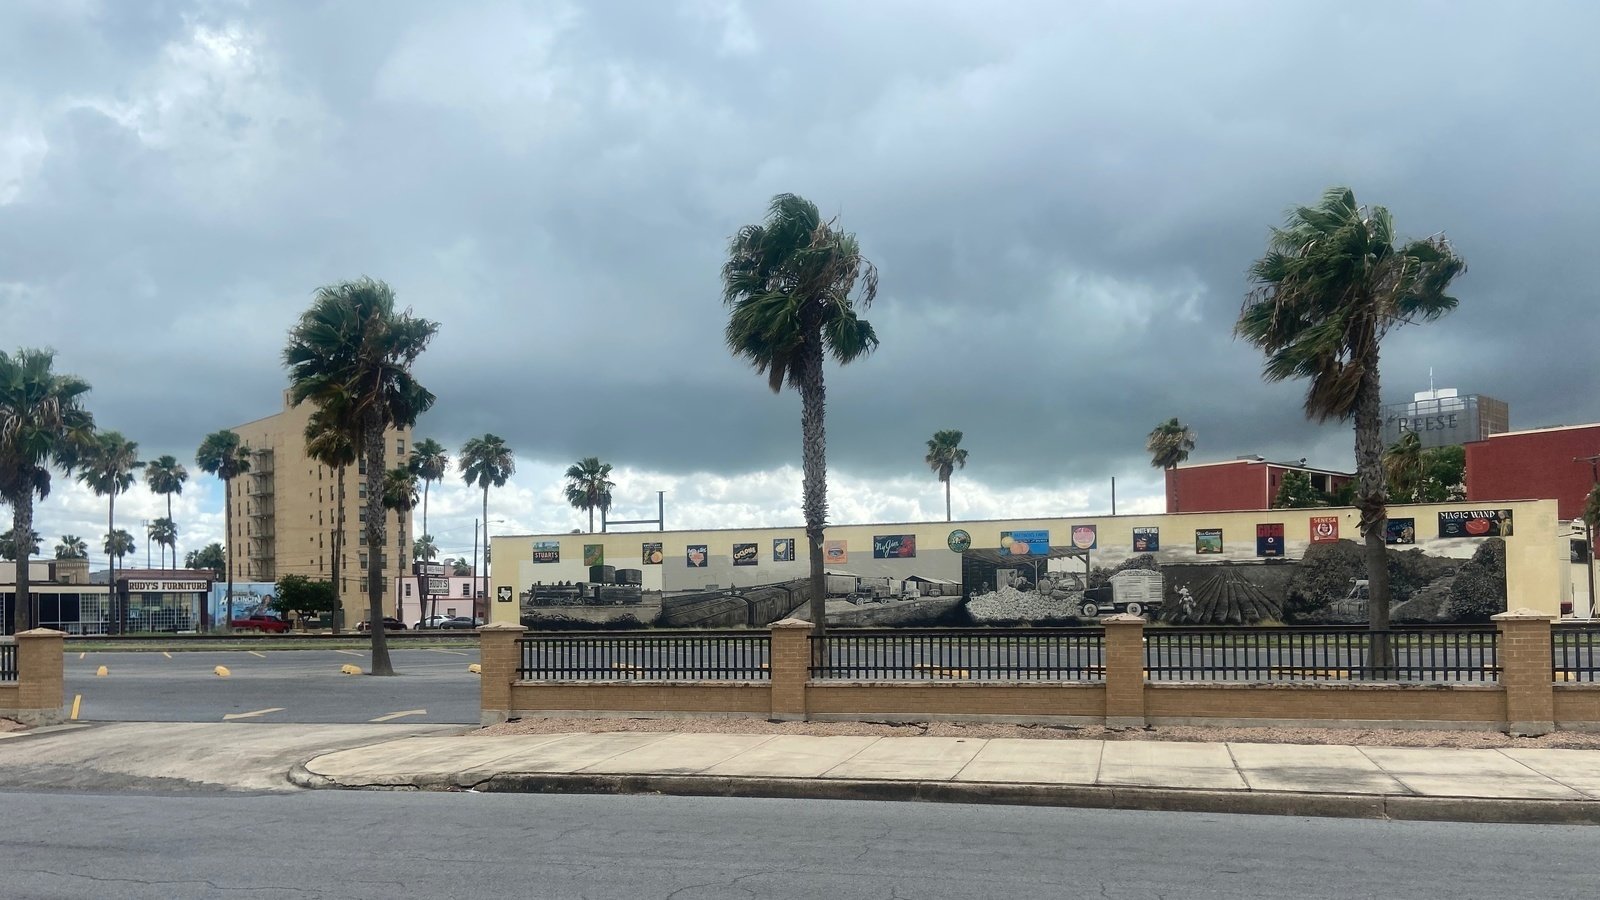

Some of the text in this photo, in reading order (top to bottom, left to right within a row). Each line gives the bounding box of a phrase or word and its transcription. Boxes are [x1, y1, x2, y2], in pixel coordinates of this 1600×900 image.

[1398, 414, 1458, 434] REESE
[1440, 510, 1496, 520] MAGIC WAND
[734, 547, 756, 559] CYCLONE
[129, 582, 208, 590] RUDY'S FURNITURE
